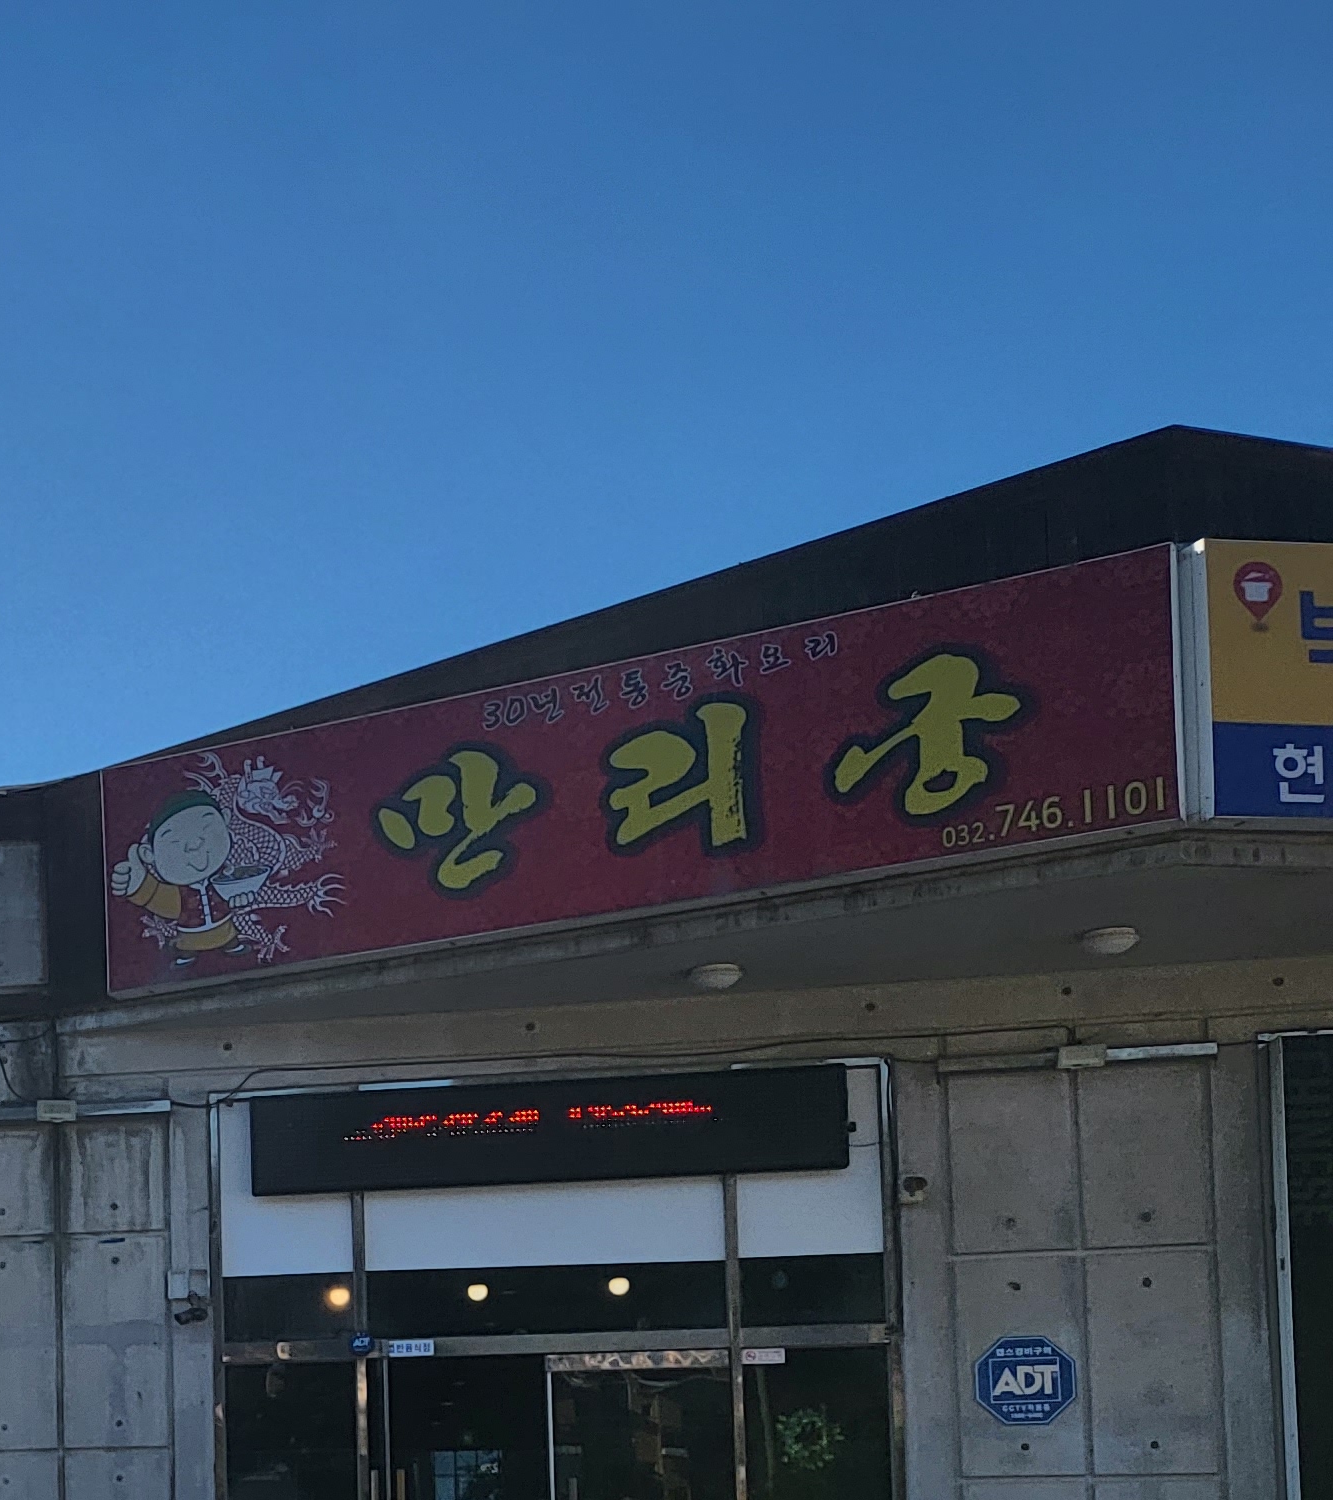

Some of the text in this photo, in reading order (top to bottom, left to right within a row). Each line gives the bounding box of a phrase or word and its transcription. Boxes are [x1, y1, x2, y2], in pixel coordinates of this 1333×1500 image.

[378, 653, 1021, 889] 만리궁
[942, 776, 1165, 848] 032.746.1101
[992, 1364, 1059, 1396] ADT
